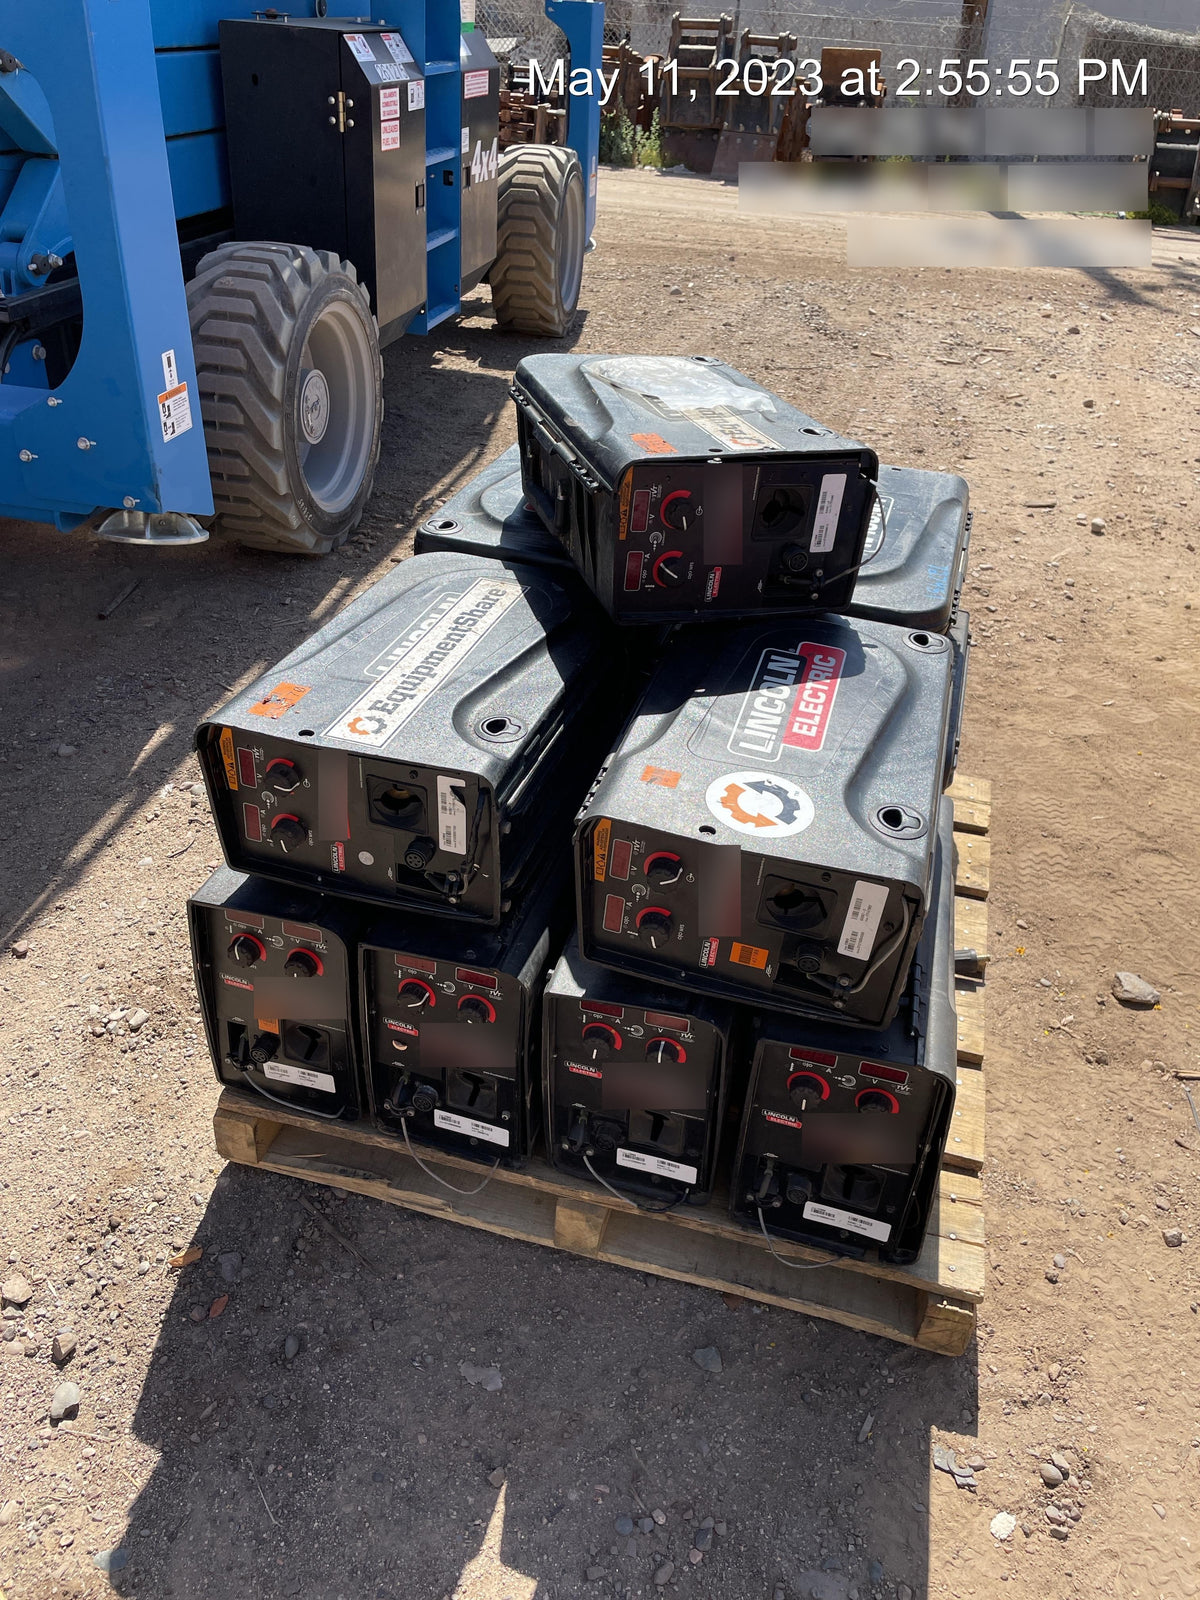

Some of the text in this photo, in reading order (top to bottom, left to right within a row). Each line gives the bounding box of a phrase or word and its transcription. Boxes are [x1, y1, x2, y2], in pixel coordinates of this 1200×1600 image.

[471, 138, 498, 183] 4x4
[706, 573, 715, 600] LINCOLN
[368, 588, 507, 715] EquipmentShare
[738, 654, 801, 755] LINCOLN
[791, 653, 838, 738] ELECTRIC
[700, 942, 711, 966] LINCOLN
[708, 940, 718, 963] ELECTRIC
[221, 974, 248, 984] LINCOLN
[384, 1018, 412, 1030] LINCOLN
[566, 1061, 596, 1072] LINCOLN
[764, 1110, 796, 1122] LINCOLN
